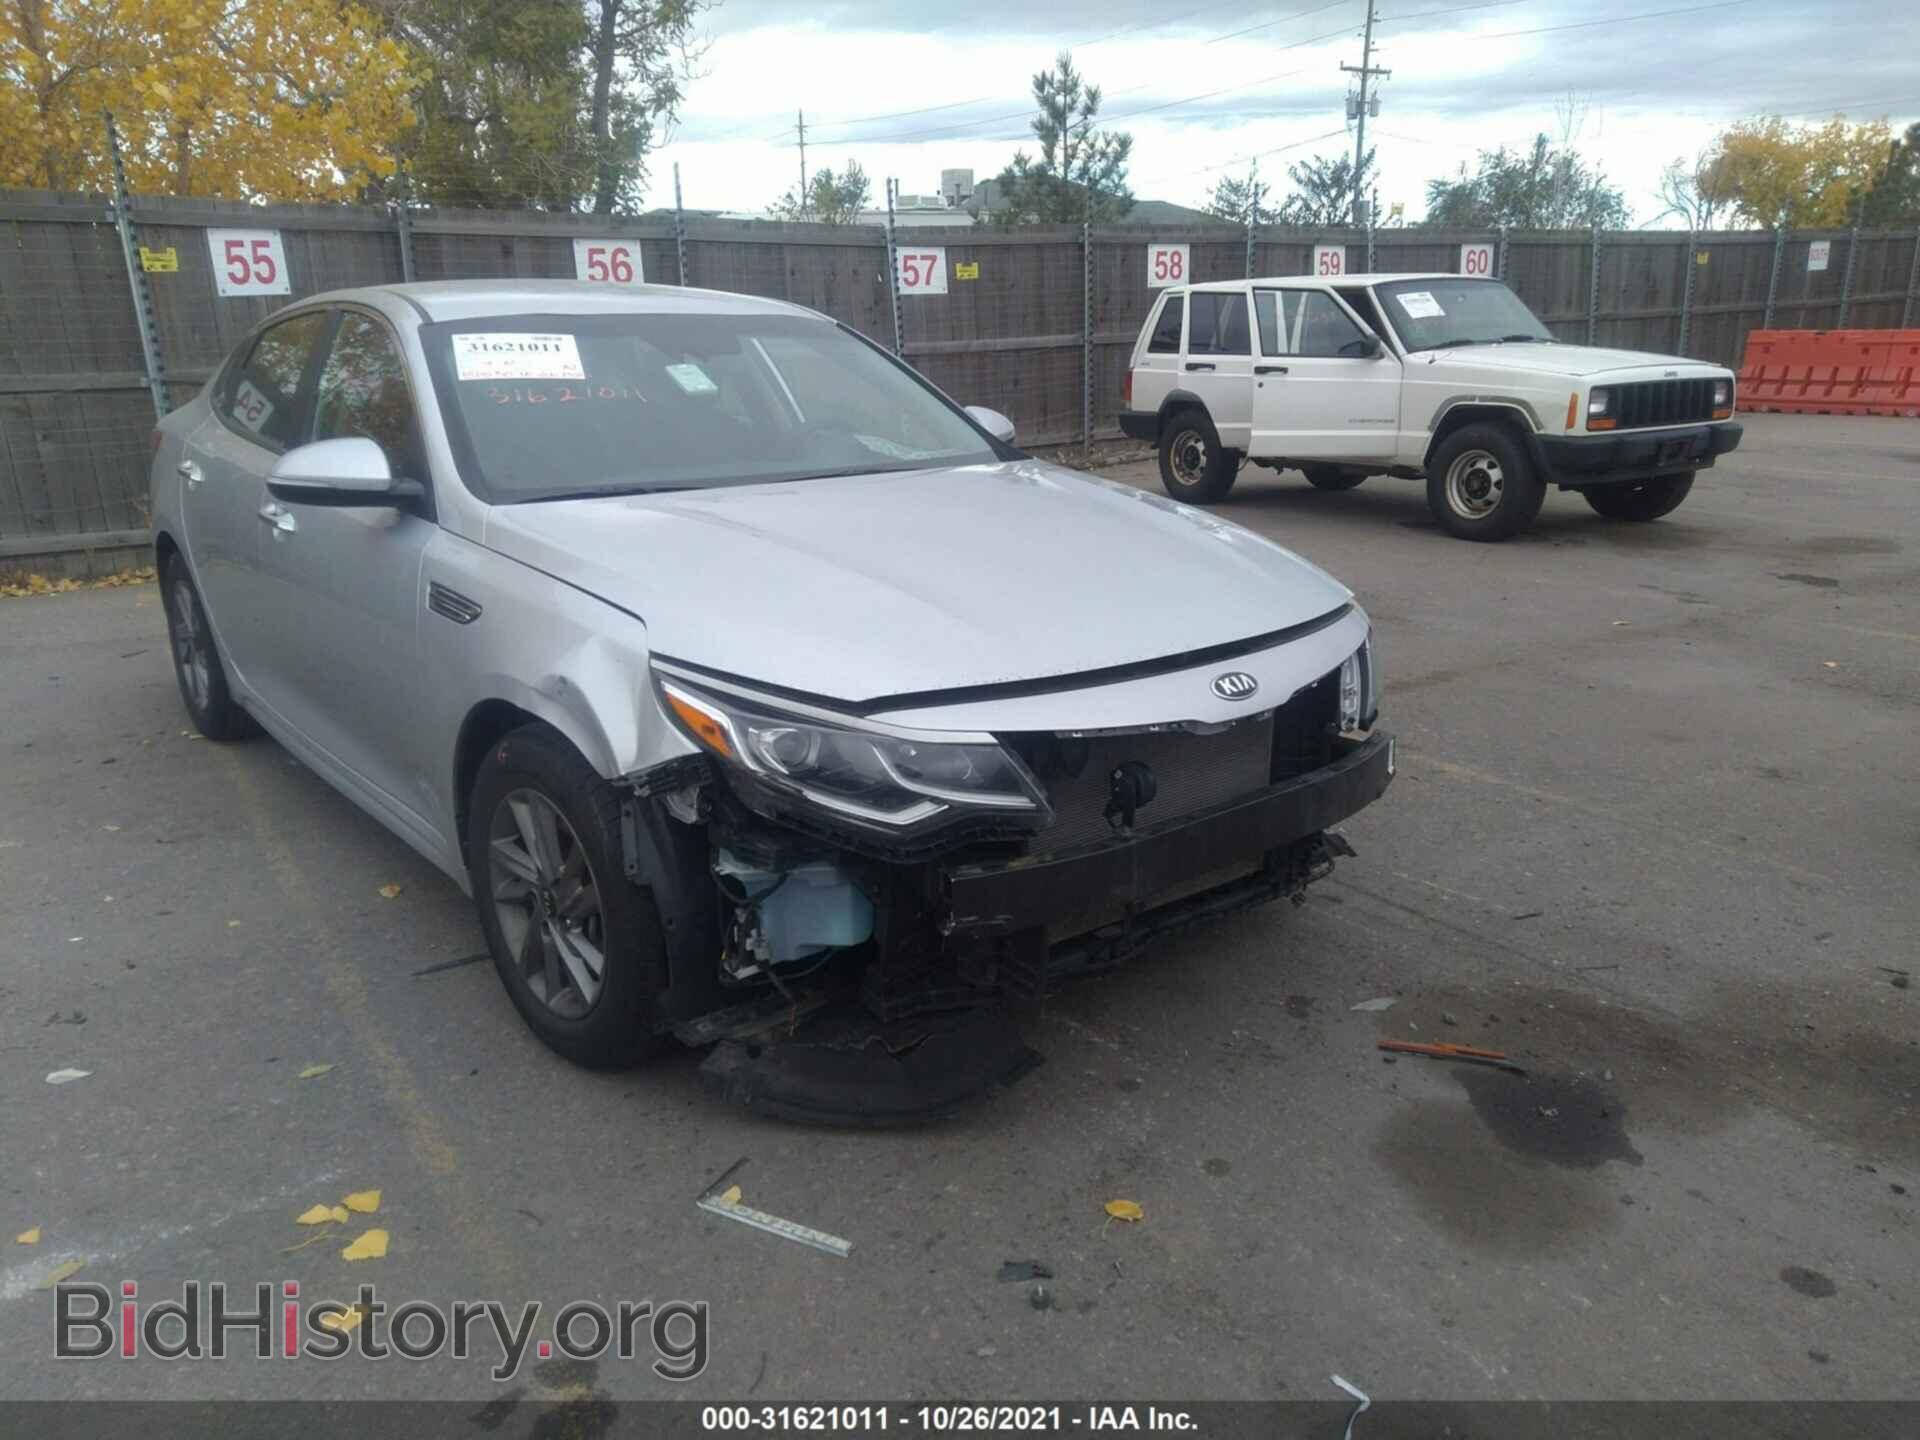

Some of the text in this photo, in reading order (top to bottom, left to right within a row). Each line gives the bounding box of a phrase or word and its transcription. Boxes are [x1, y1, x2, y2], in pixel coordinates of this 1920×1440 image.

[224, 239, 276, 285] 55
[587, 247, 633, 282] 56
[902, 254, 938, 287] 57
[1155, 250, 1182, 280] 58
[1320, 251, 1340, 276] 59
[1466, 249, 1488, 274] 60
[466, 342, 562, 352] 31621011
[1217, 673, 1256, 695] KIA
